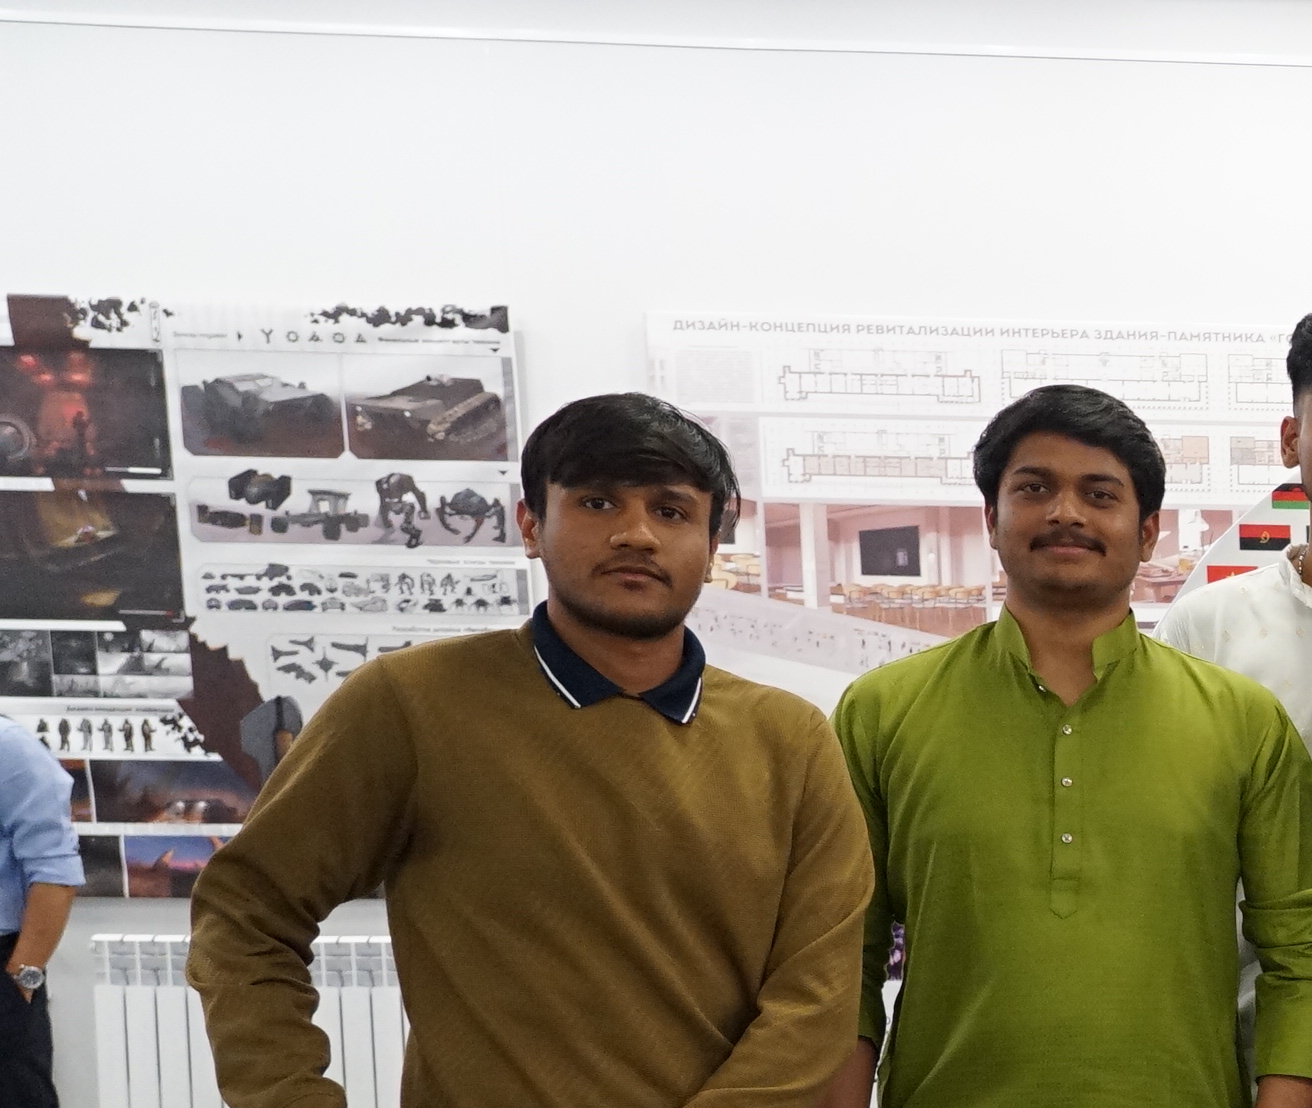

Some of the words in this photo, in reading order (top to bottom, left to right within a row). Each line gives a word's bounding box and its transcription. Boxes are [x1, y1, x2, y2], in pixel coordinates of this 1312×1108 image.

[673, 319, 851, 334] ДИЗАЙН-КОНЦЕПЦИЯ
[856, 323, 995, 337] РЕВИТАЛИЗАЦИИ
[1000, 327, 1090, 340] ИНТЕРЬЕРА
[1095, 329, 1266, 343] ЗДАНИЯ-ПАМЯТНИКА
